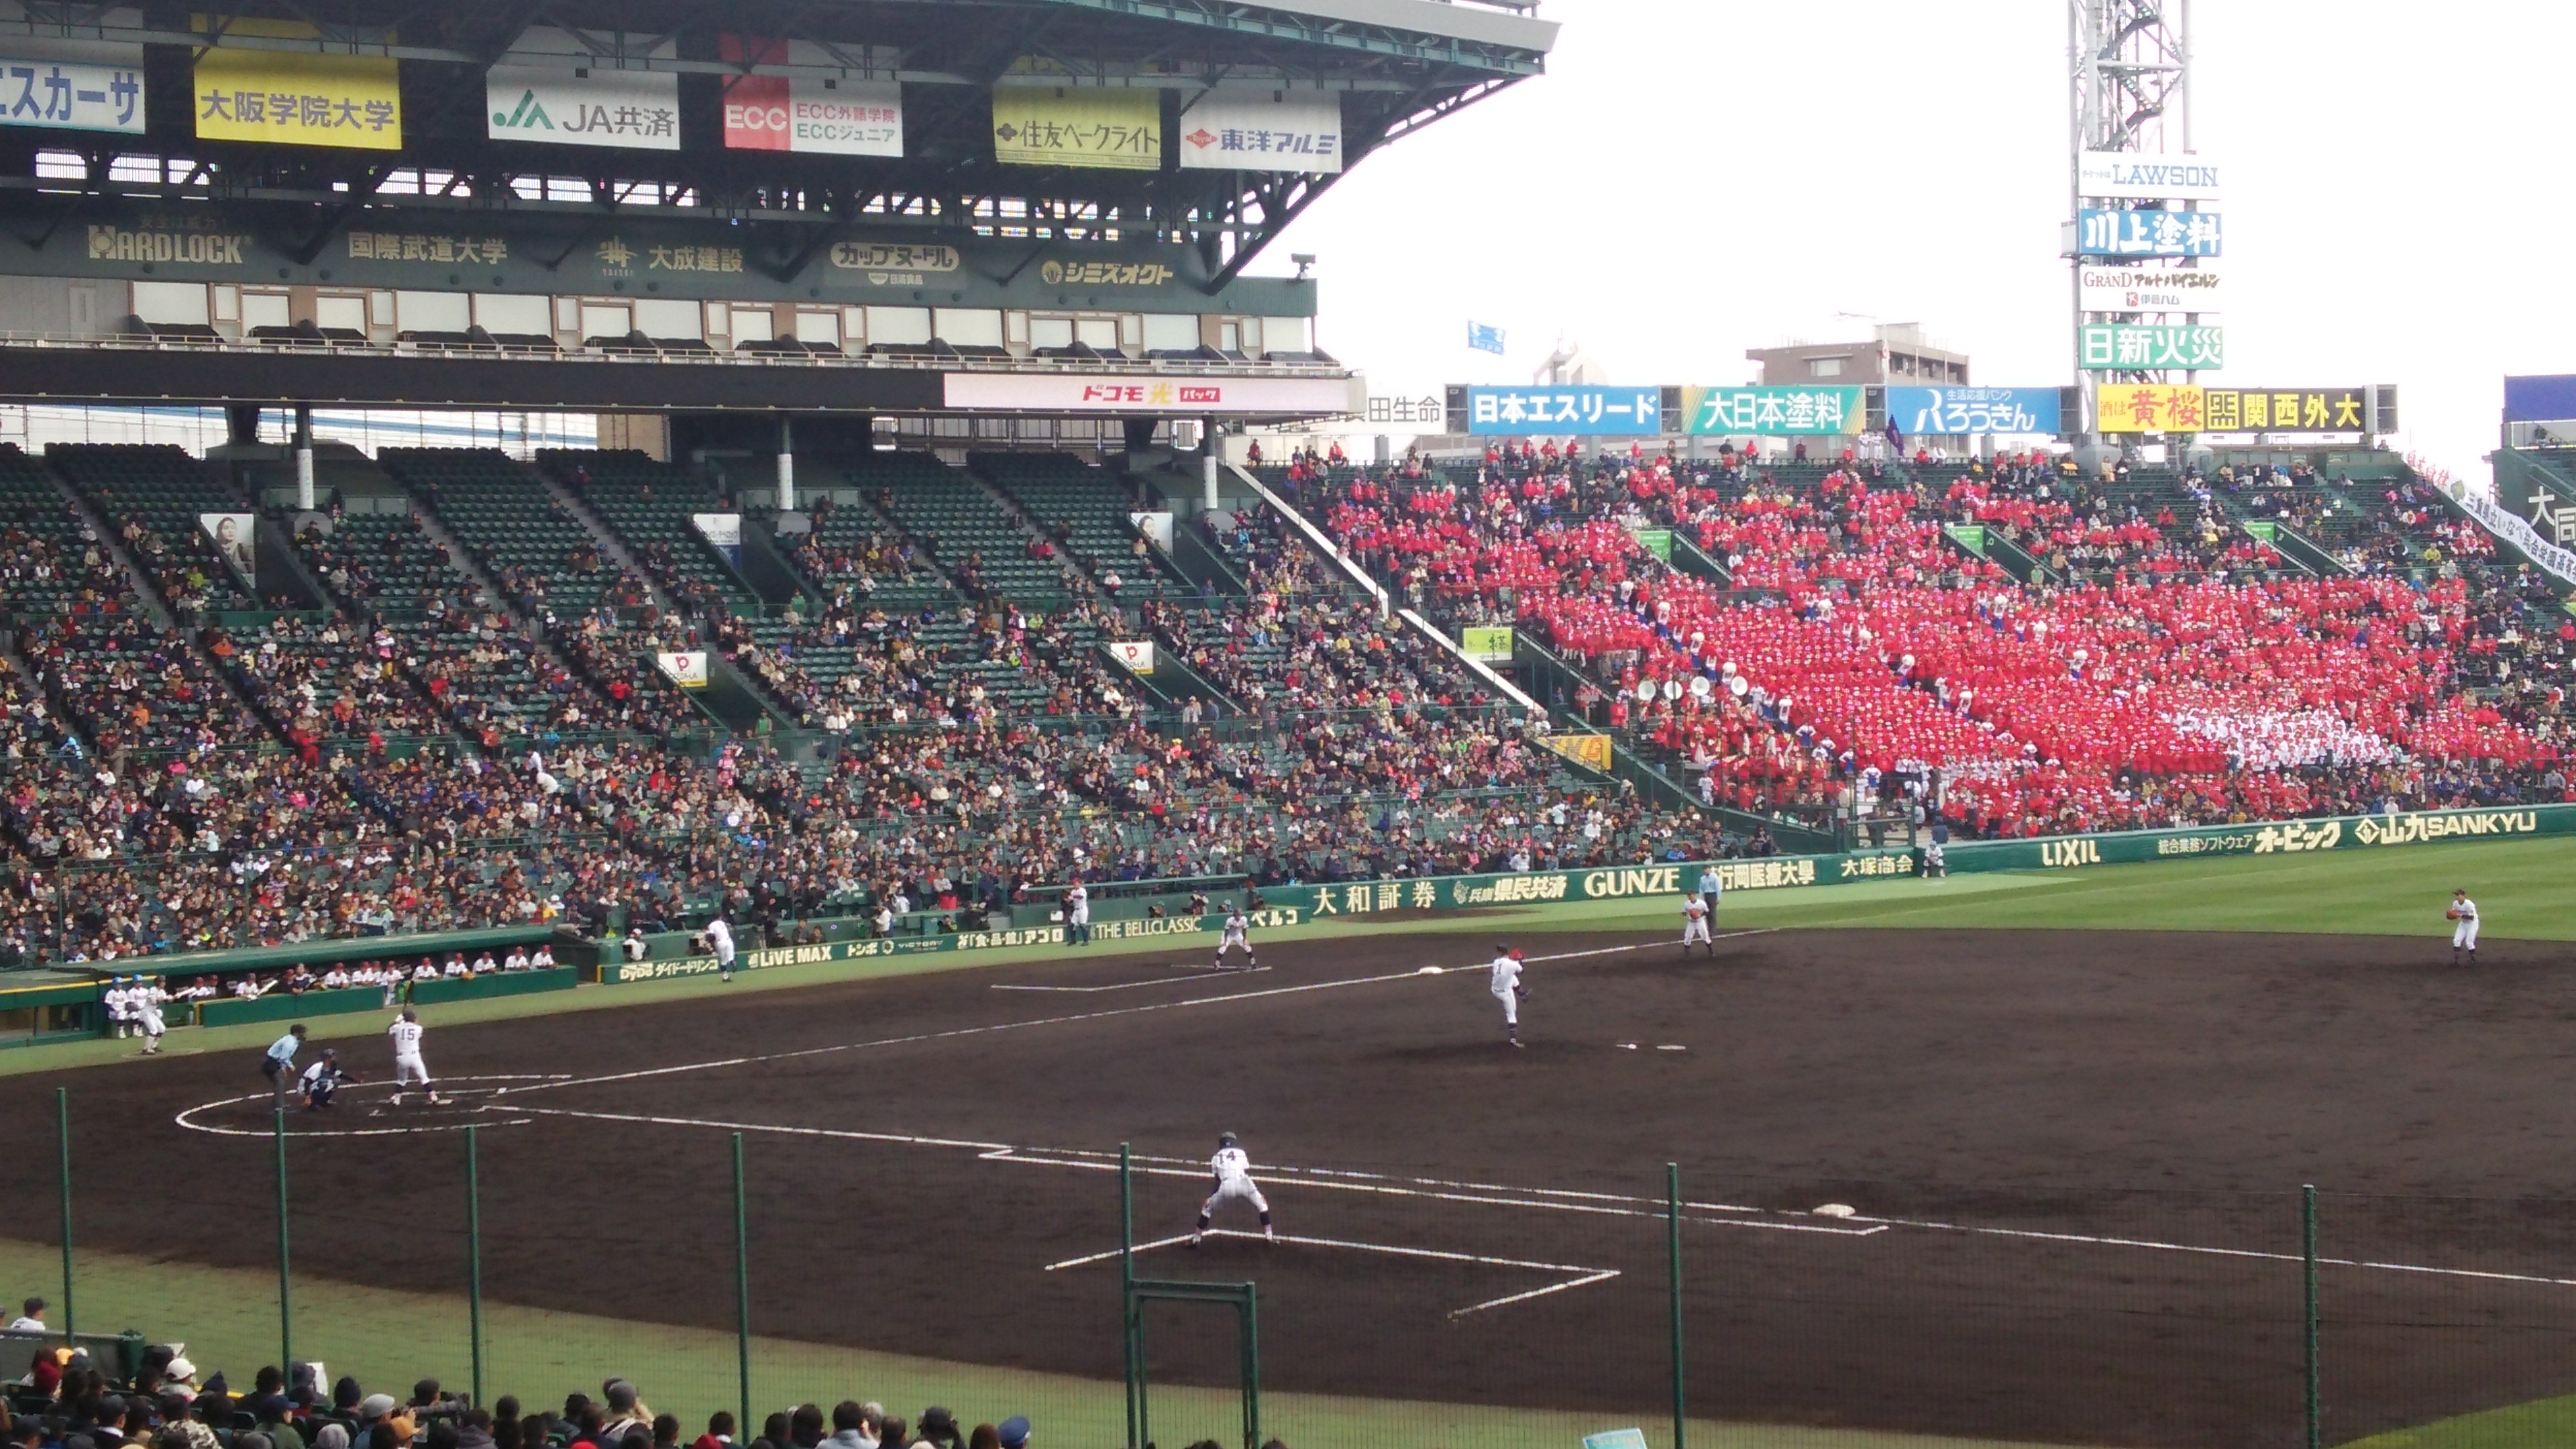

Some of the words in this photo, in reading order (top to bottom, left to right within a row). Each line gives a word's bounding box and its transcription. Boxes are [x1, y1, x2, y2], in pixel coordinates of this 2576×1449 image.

[0, 67, 139, 125] スカーサ
[201, 89, 395, 131] 大阪学院大学
[563, 105, 675, 137] JA共済
[726, 105, 788, 131] ECC
[796, 103, 896, 123] ECC外語学院
[797, 123, 896, 142] ECCジュニア
[1020, 121, 1159, 153] 住友ベークライト
[1220, 129, 1336, 154] 東洋アルミ
[2112, 164, 2218, 186] LAWSON
[88, 225, 243, 264] HARDLOCK
[2086, 211, 2220, 254] 川上塗料
[349, 232, 508, 265] 国際武道大学
[649, 245, 743, 273] 大成建設
[839, 244, 953, 268] カップヌードル
[1065, 262, 1173, 285] シミズオクト
[2083, 271, 2133, 288] GRAND
[2085, 328, 2222, 364] 日新火災
[1345, 396, 1441, 423] 田生命
[1474, 393, 1657, 424] 日本エスリード
[1705, 392, 1843, 429] 大日本塗料
[1947, 403, 2036, 431] ろうきん
[2244, 393, 2361, 428] 関西外大
[2254, 821, 2341, 853] オービック
[1841, 854, 1914, 877] 大塚商会
[2042, 839, 2101, 867] LIXIL
[1584, 867, 1680, 898] GUNZE
[1313, 881, 1436, 916] 大和証券
[1095, 922, 1122, 940] THE
[1250, 909, 1298, 927] ベルコ
[797, 945, 833, 963] MAX
[847, 941, 879, 957] トンボ
[400, 1028, 415, 1040] 15
[1219, 1150, 1236, 1165] 14
